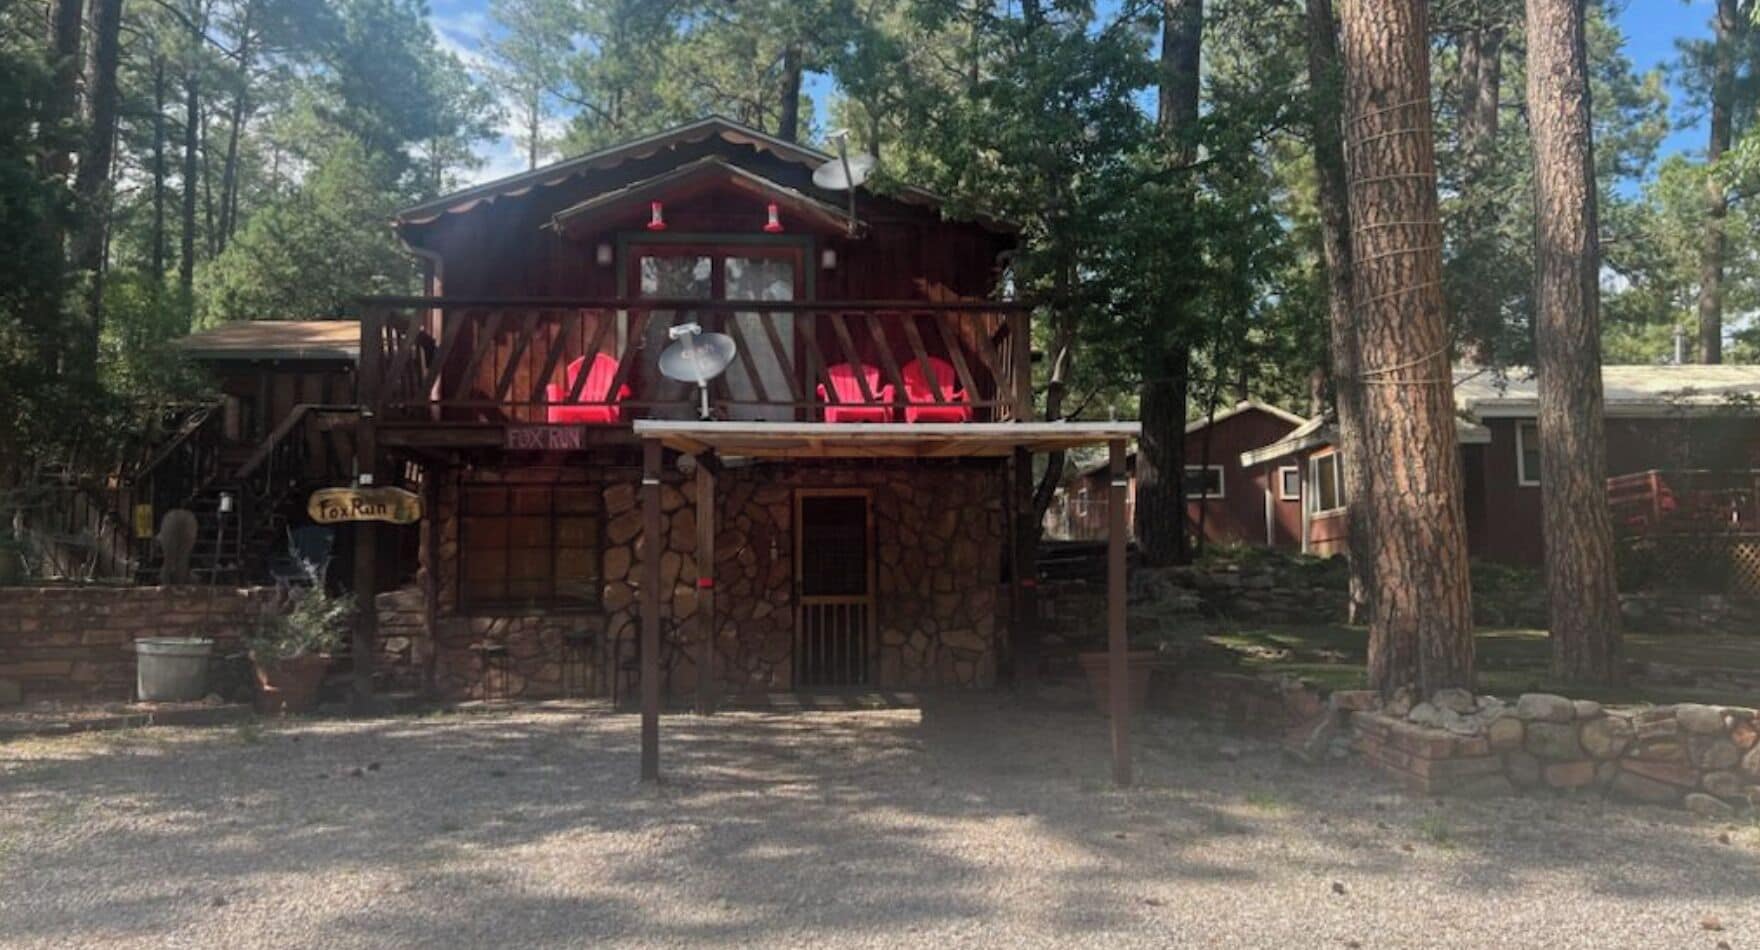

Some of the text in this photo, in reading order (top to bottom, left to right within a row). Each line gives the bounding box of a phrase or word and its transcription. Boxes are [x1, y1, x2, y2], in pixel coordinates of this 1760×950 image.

[508, 429, 581, 449] FOX RUN
[319, 497, 386, 519] Fox Run
